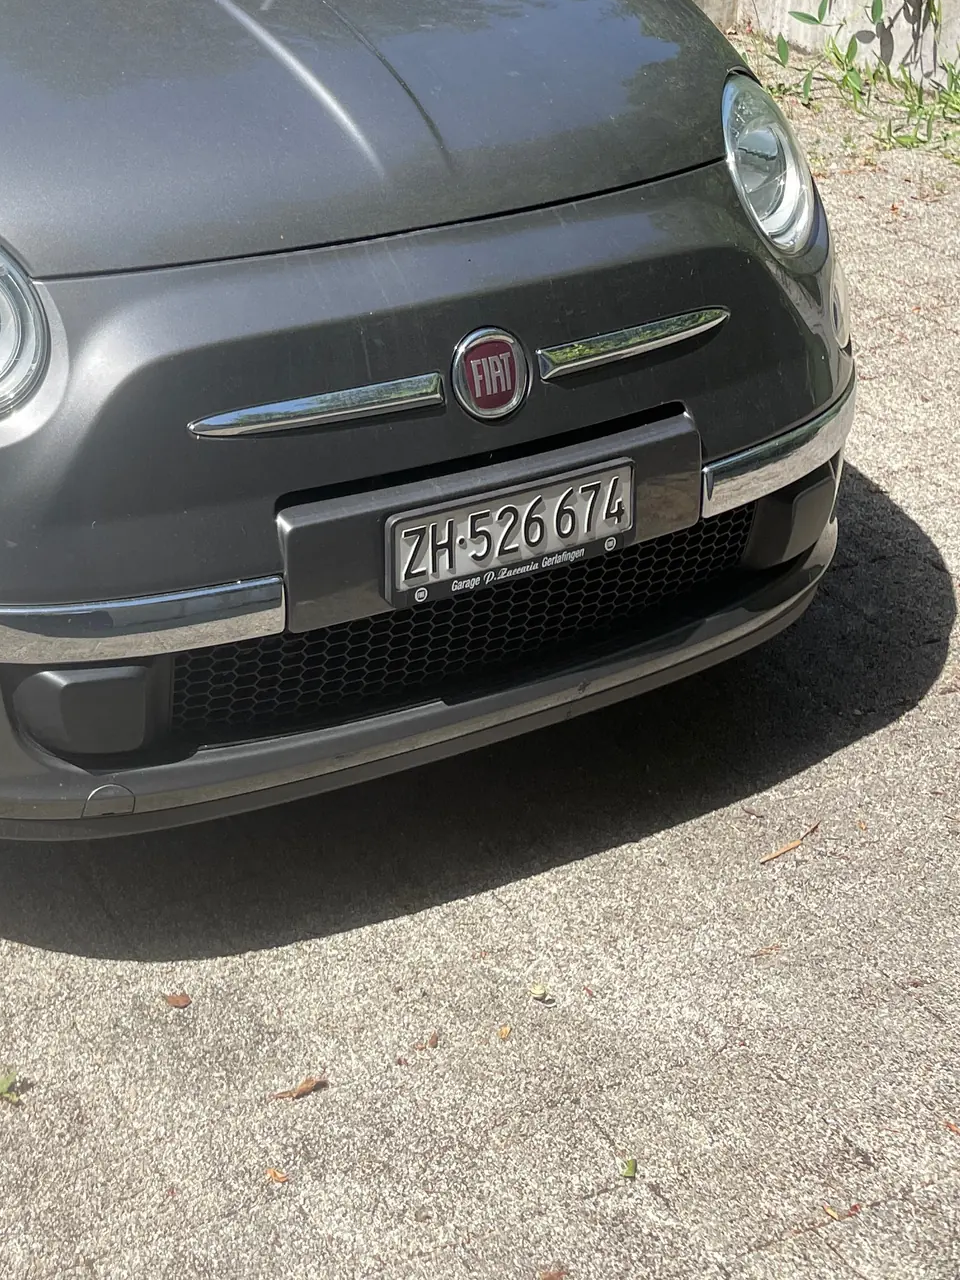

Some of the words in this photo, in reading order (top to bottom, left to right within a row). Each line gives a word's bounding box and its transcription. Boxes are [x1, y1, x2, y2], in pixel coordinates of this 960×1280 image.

[471, 352, 512, 398] FIAT
[554, 476, 625, 539] 674
[451, 575, 481, 592] Garage
[541, 547, 585, 568] Gerlafingen
